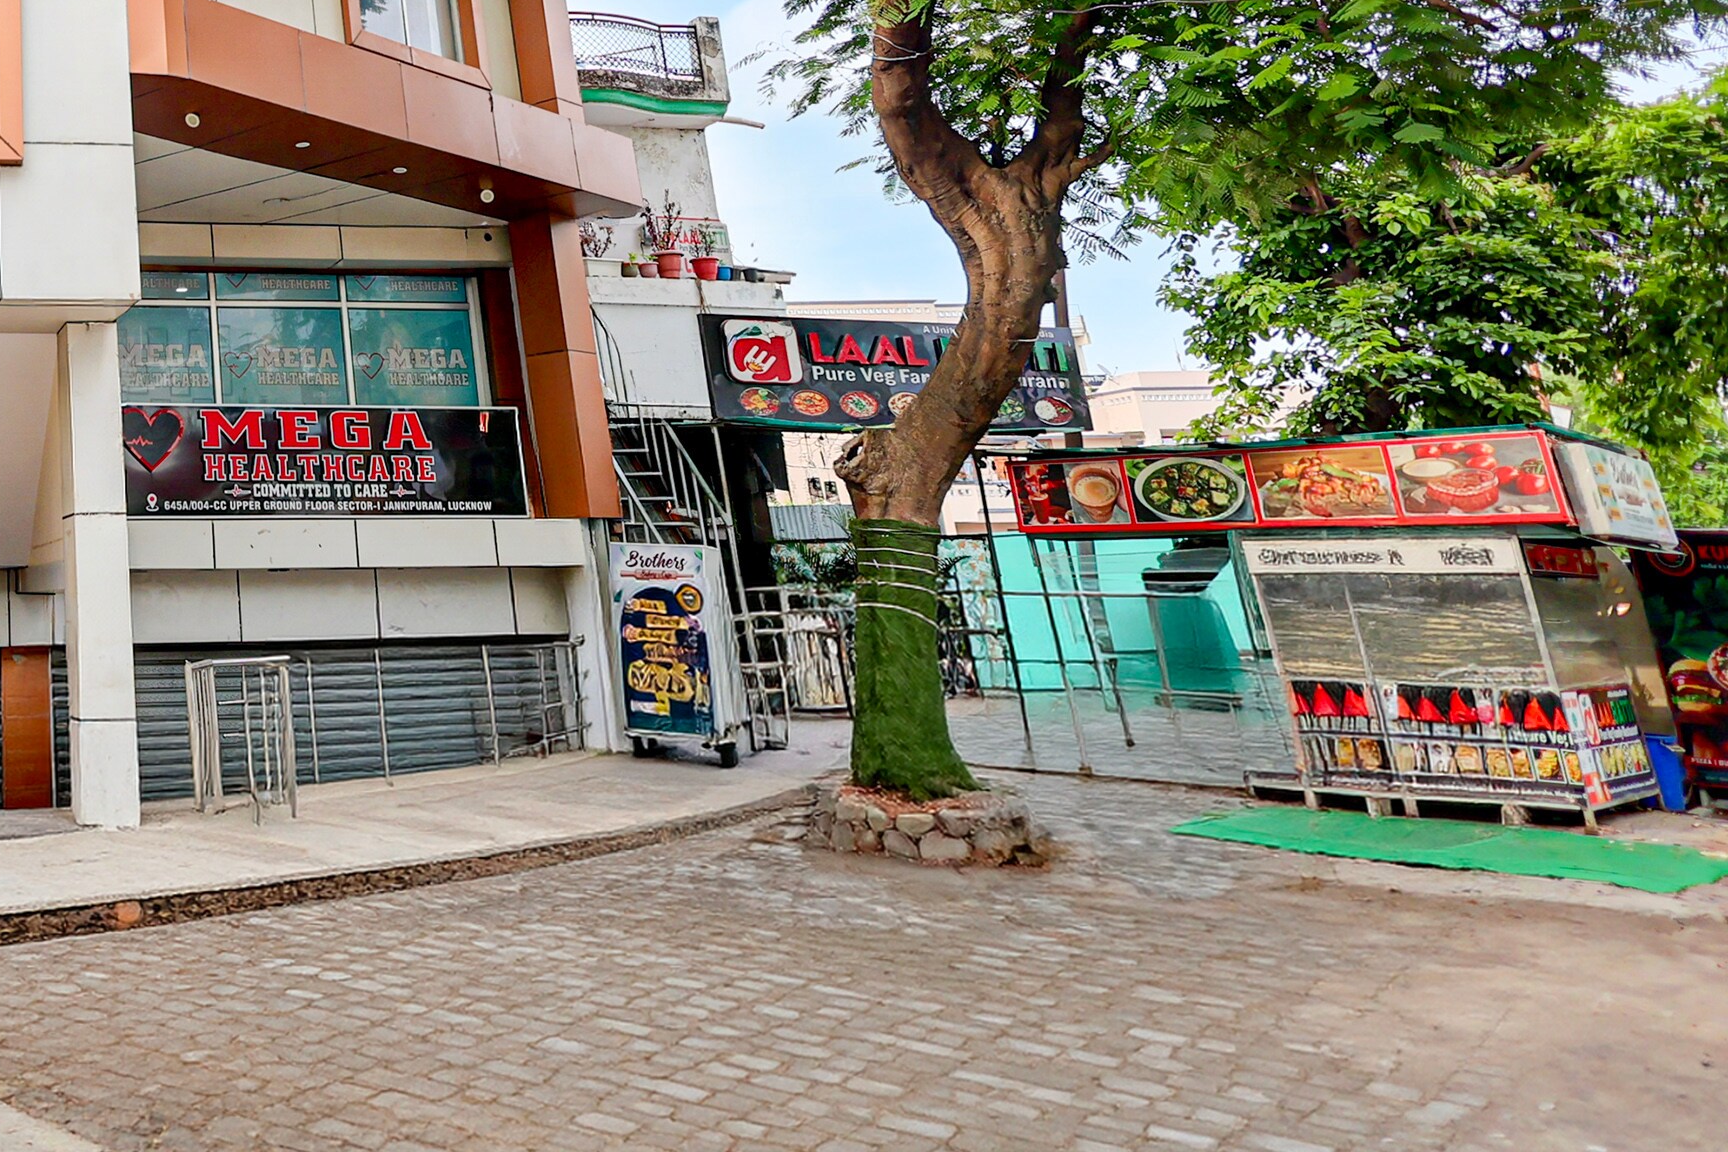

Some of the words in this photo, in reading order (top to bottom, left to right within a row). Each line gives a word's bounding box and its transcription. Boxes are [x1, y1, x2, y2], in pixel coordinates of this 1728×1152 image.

[143, 278, 200, 289] ALTHCARE
[261, 279, 331, 290] HEALTHCARE
[390, 281, 459, 292] HEALTHCARE
[118, 342, 208, 368] MEGA
[256, 347, 338, 368] MEGA
[387, 348, 468, 369] MEGA
[805, 331, 930, 367] LAAL
[257, 371, 340, 386] HEALTHCARE
[389, 372, 470, 387] HEALTHCARE
[812, 366, 856, 383] Pure
[860, 367, 897, 385] Veg
[199, 409, 432, 450] MEGA
[203, 454, 437, 482] HEALTHCARE
[253, 483, 331, 498] COMMITTED
[334, 484, 352, 498] TO
[355, 484, 389, 498] CARE
[163, 500, 227, 512] 645A/004-CC
[229, 500, 262, 512] UPPER
[263, 500, 303, 512] GROUND
[305, 500, 335, 512] FLOOR
[383, 500, 446, 513] JANKIPURAM,
[448, 500, 493, 512] LUCKNOW
[625, 550, 687, 572] Brothers
